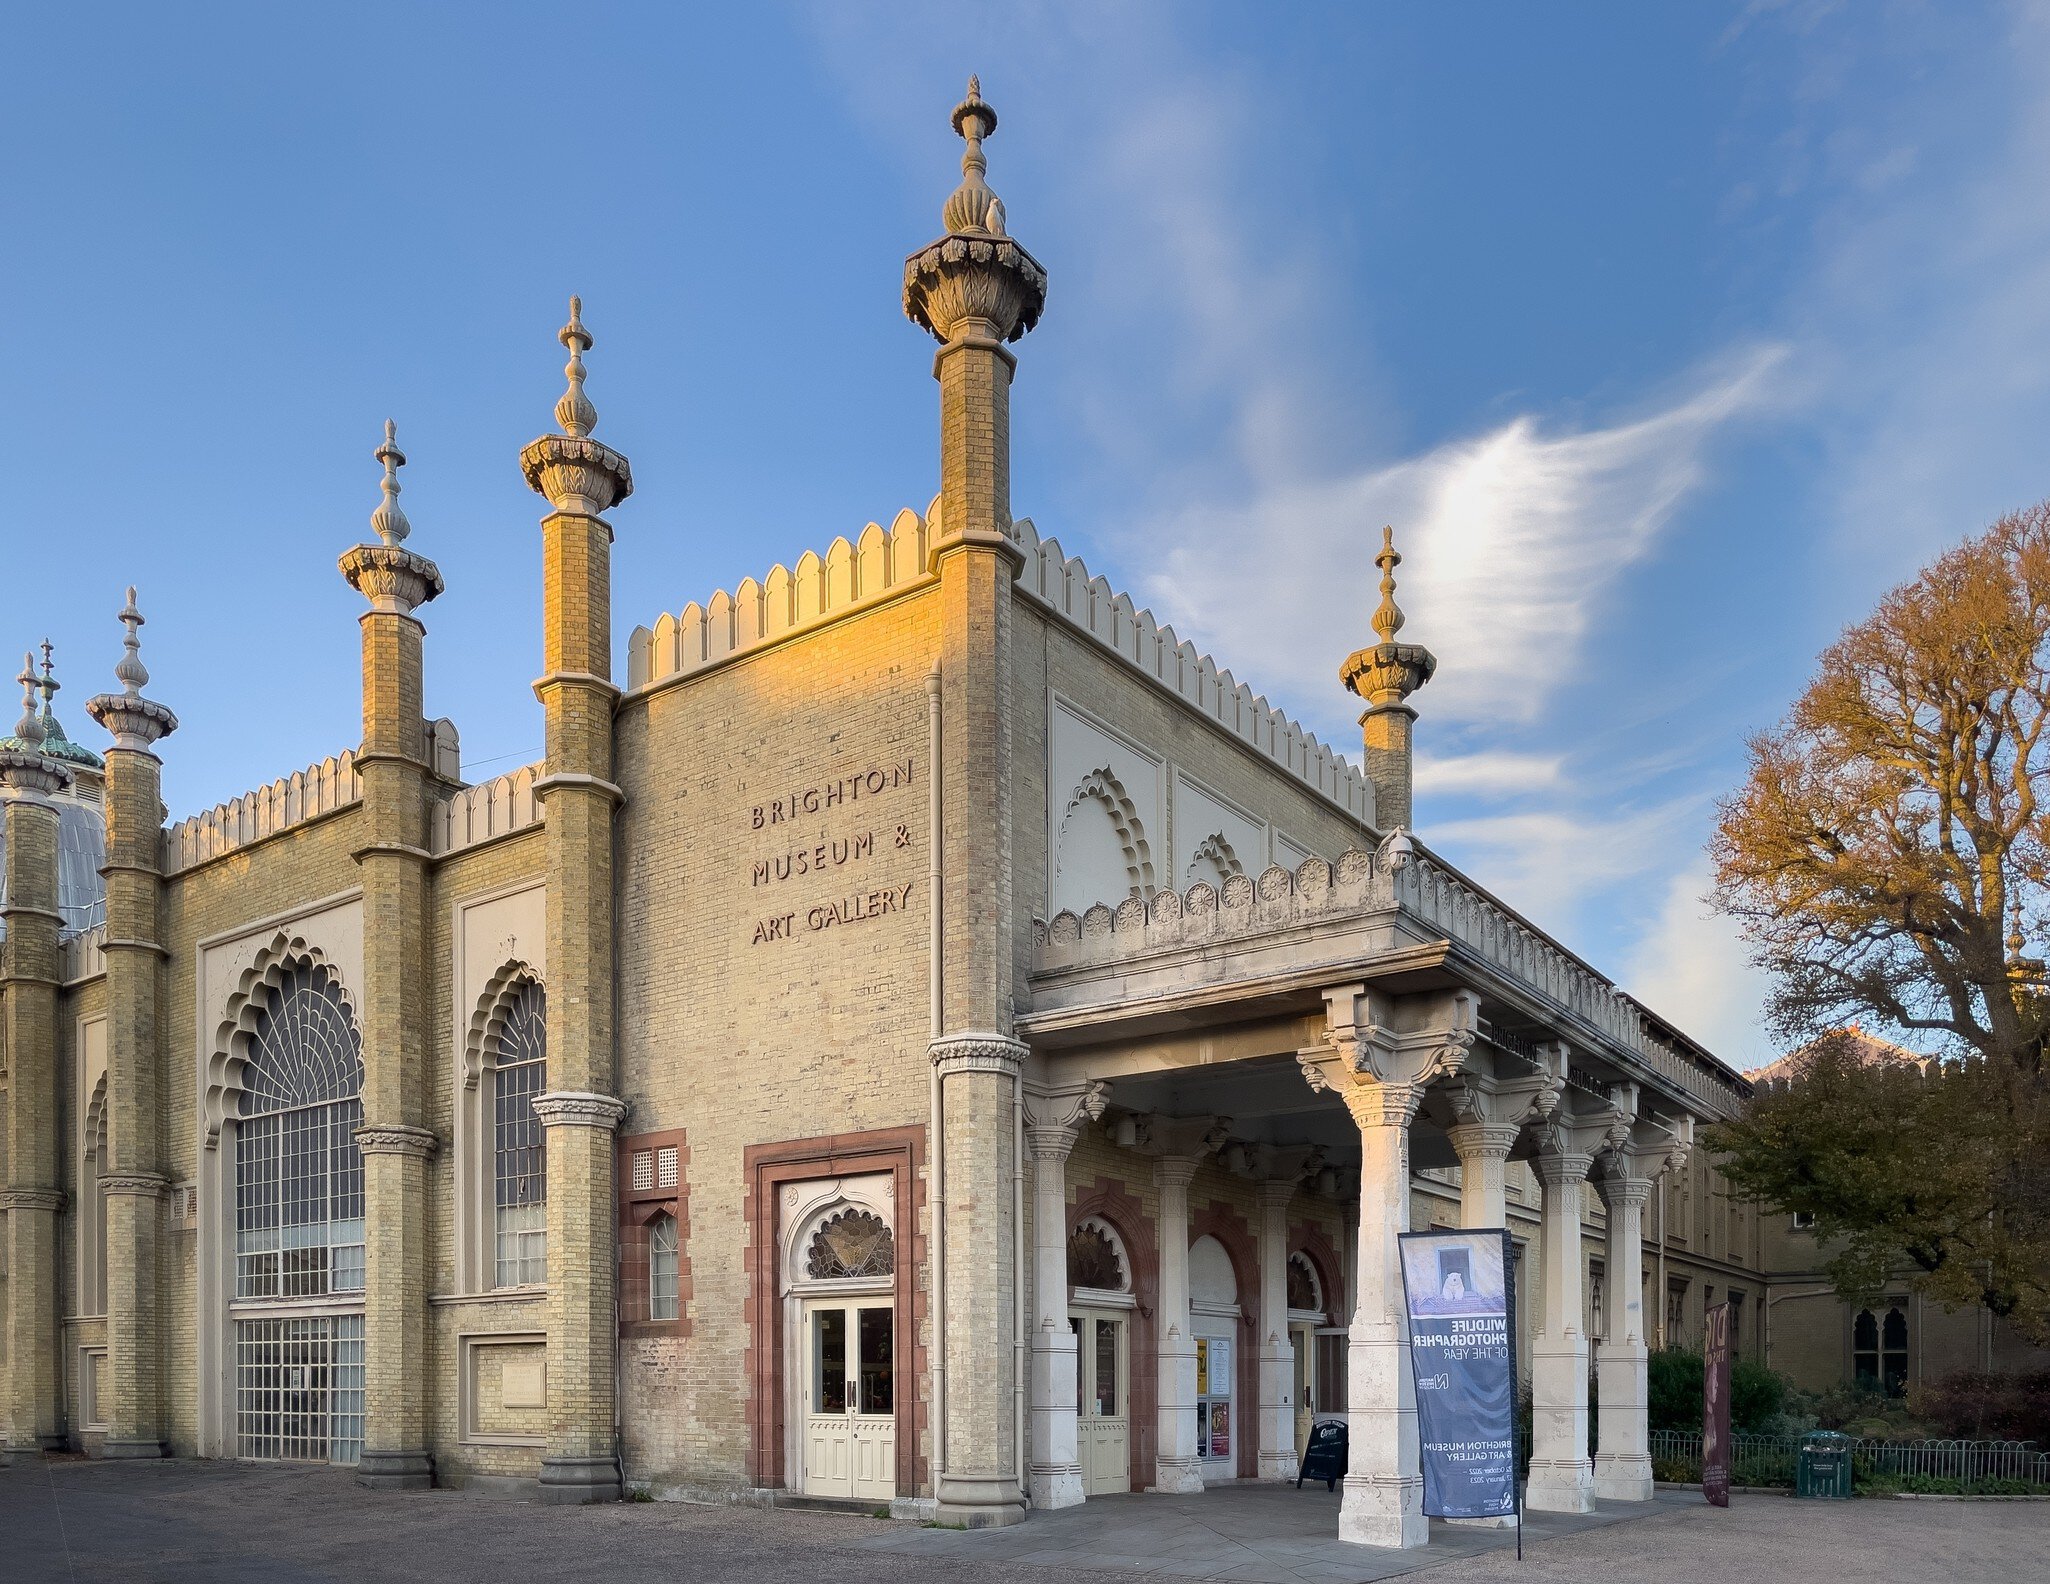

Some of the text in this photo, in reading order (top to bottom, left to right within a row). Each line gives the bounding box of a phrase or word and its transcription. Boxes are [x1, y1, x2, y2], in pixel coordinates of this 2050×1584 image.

[751, 758, 913, 829] BRIGHTON
[752, 823, 912, 887] MUSEUM &
[751, 882, 912, 945] ART GALLERY
